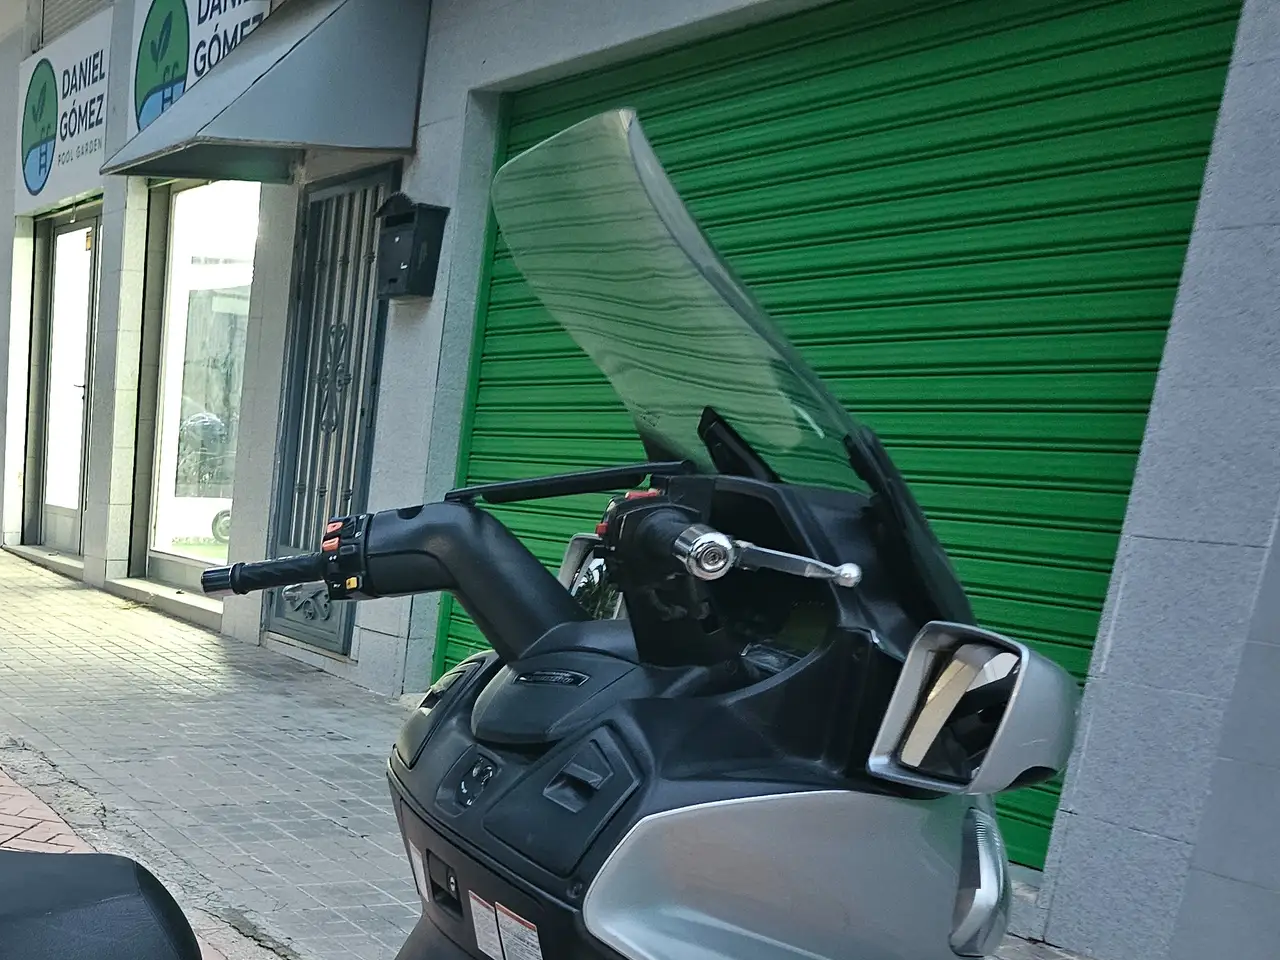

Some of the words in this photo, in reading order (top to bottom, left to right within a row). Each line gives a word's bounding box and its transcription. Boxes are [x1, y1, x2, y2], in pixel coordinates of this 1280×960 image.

[62, 49, 106, 100] DANIEL
[60, 93, 104, 142] GÓMEZ
[57, 149, 74, 167] POOL
[75, 138, 103, 159] GARDEN
